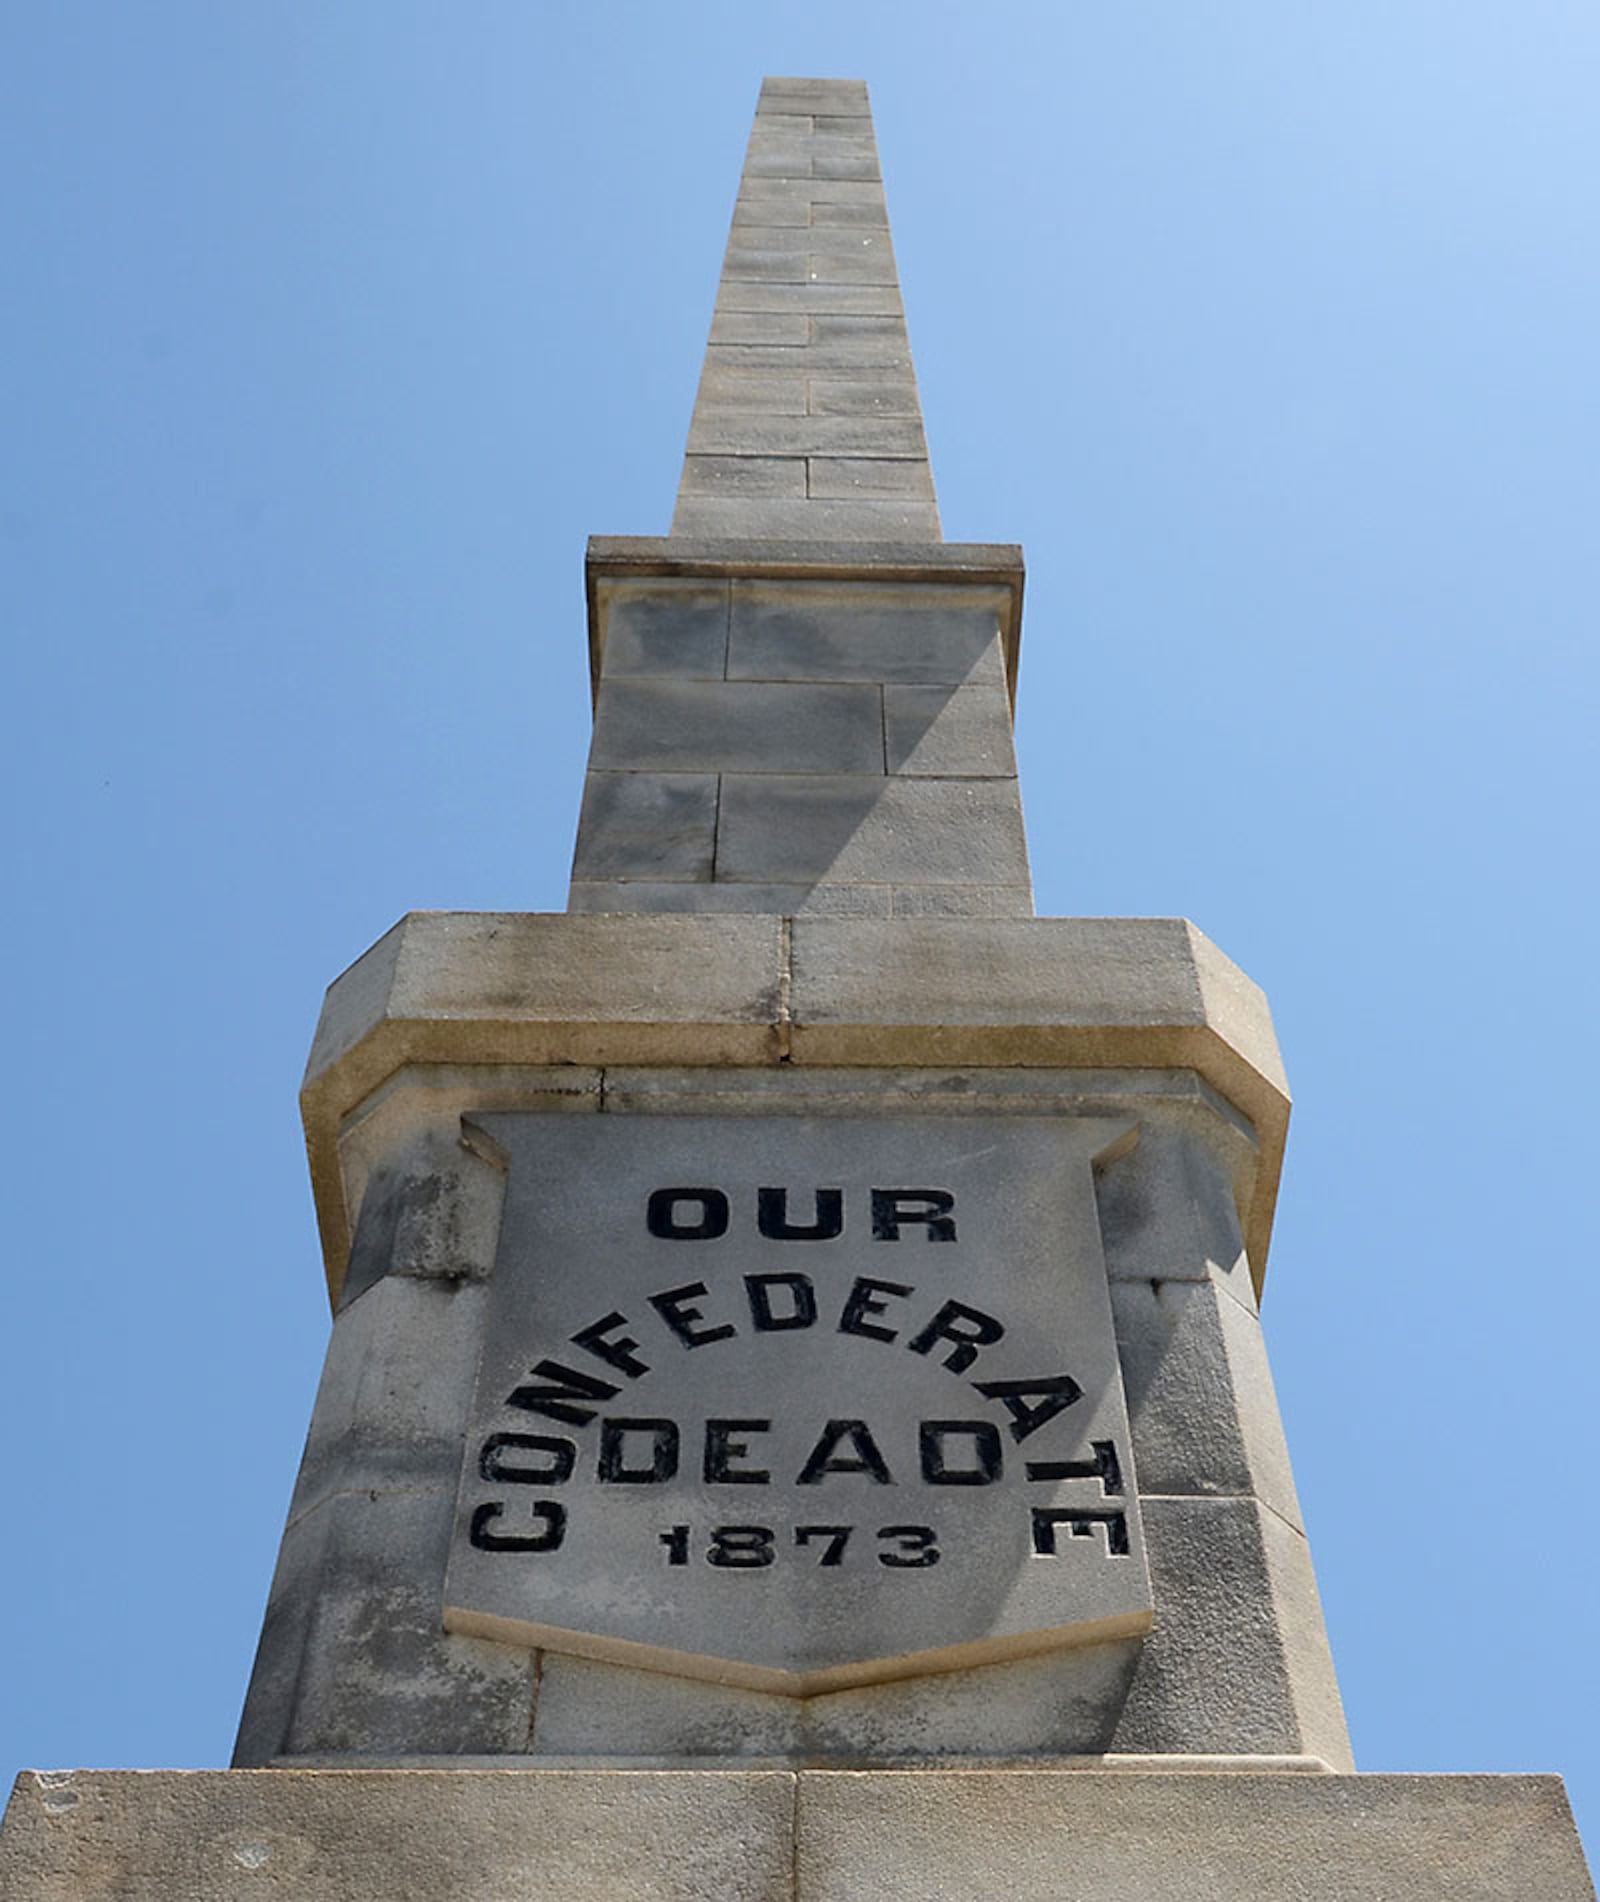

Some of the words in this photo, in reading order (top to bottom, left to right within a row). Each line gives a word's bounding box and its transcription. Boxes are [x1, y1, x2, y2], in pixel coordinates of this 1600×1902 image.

[647, 1187, 957, 1242] OUR
[470, 1272, 1130, 1558] CONFEDERATE
[598, 1419, 1003, 1485] DEAD
[659, 1526, 941, 1567] 1873
